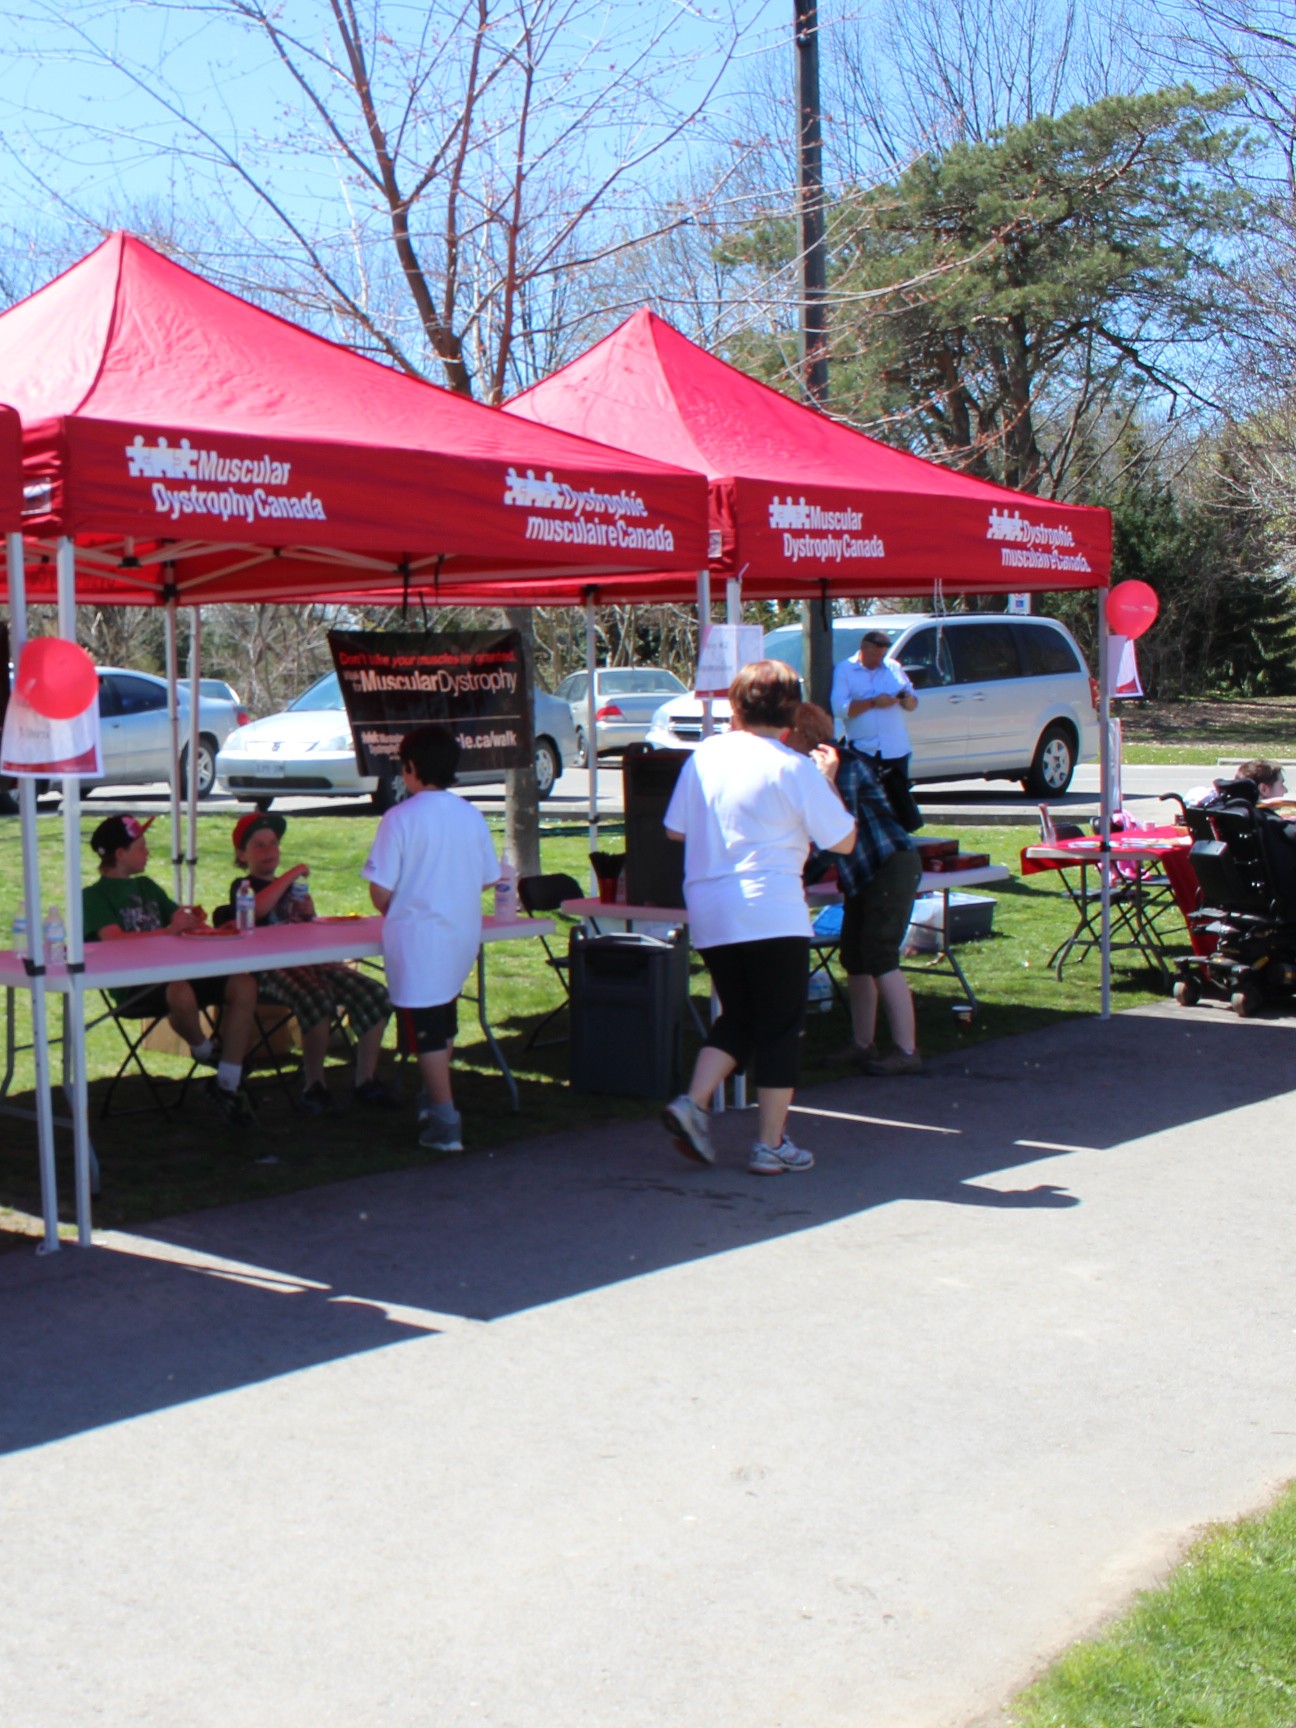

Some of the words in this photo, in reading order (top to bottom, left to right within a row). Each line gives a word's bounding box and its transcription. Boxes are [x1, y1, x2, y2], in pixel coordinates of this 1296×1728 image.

[198, 449, 290, 486] Muscular
[560, 483, 648, 518] Dystrophie
[810, 505, 862, 531] Muscular
